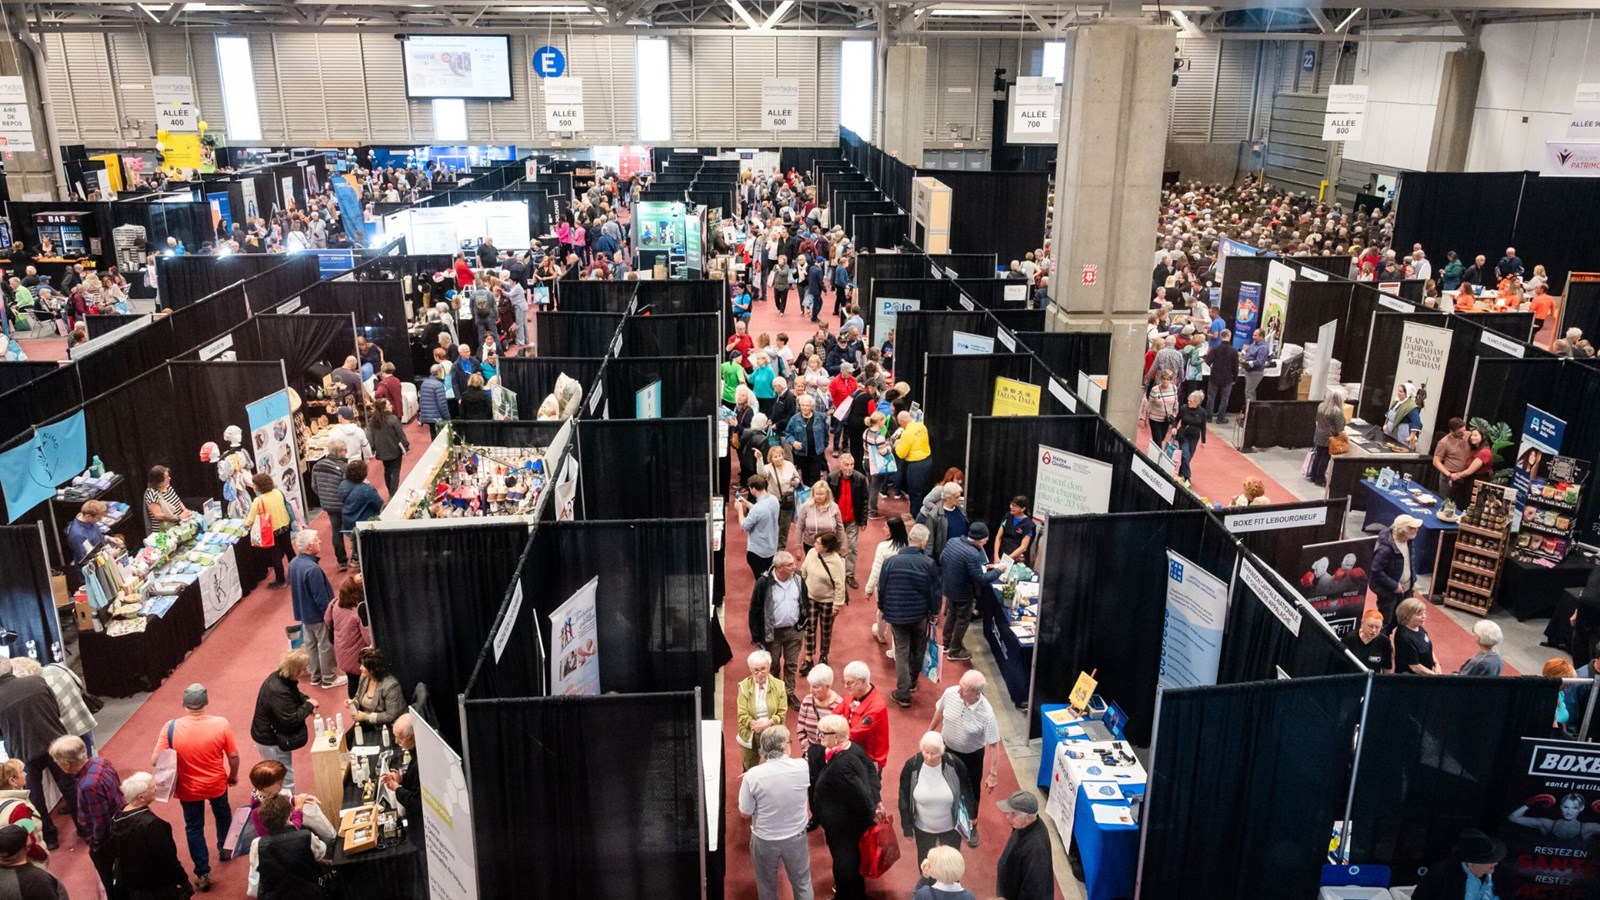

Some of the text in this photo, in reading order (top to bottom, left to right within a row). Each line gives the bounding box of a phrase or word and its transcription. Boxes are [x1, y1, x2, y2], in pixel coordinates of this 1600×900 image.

[541, 52, 557, 73] E
[1303, 54, 1313, 67] 22
[163, 108, 189, 116] ALLÉE
[552, 109, 578, 117] ALLÉE
[767, 108, 792, 116] ALLÉE
[1020, 110, 1048, 118] ALLÉE
[1331, 118, 1356, 126] ALLÉE
[1405, 336, 1434, 347] PLAINES
[1406, 350, 1442, 364] PLAINS OF
[1406, 358, 1441, 371] ABRAHAM
[997, 390, 1036, 406] FALUN DAFA
[1052, 455, 1067, 464] Héma
[1040, 472, 1083, 492] Un seul don
[1038, 482, 1088, 502] peut changer
[1054, 496, 1063, 505] de
[1232, 519, 1253, 528] BOXE
[1266, 513, 1318, 524] LEBOURGNEUF
[1337, 624, 1352, 635] FIT
[1534, 846, 1588, 858] RESTEZ EN
[1534, 874, 1573, 886] RESTEZ
